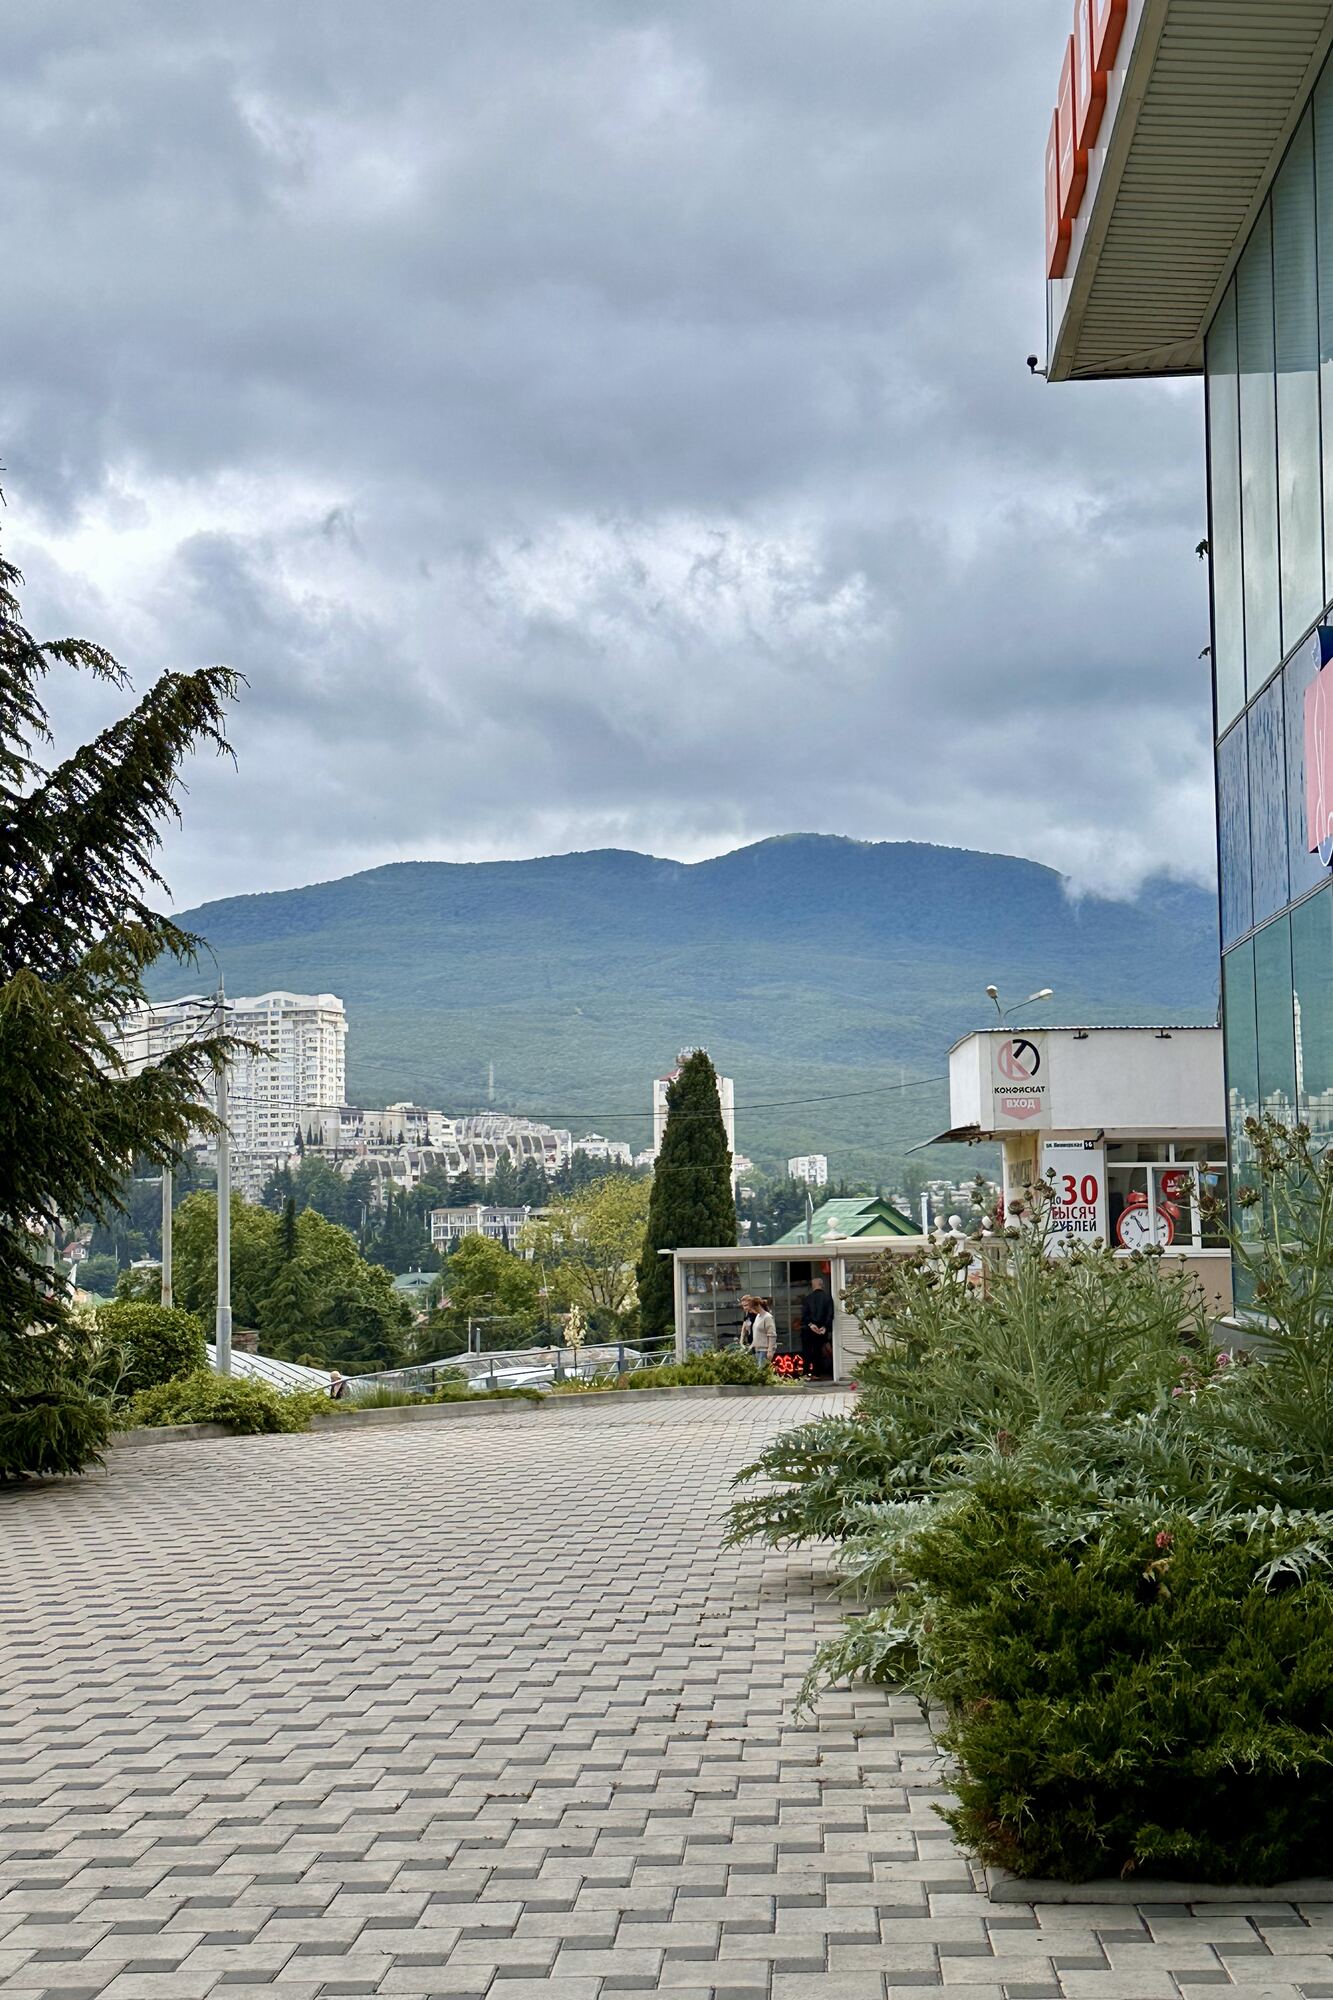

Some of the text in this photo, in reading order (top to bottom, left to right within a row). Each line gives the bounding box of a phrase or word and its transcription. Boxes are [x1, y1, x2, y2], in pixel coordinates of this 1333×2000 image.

[1006, 1099, 1035, 1109] ВХОД
[1062, 1175, 1098, 1205] 30
[1052, 1206, 1096, 1220] ТЫСЯЧ
[1052, 1220, 1097, 1231] РУБЛЕЙ
